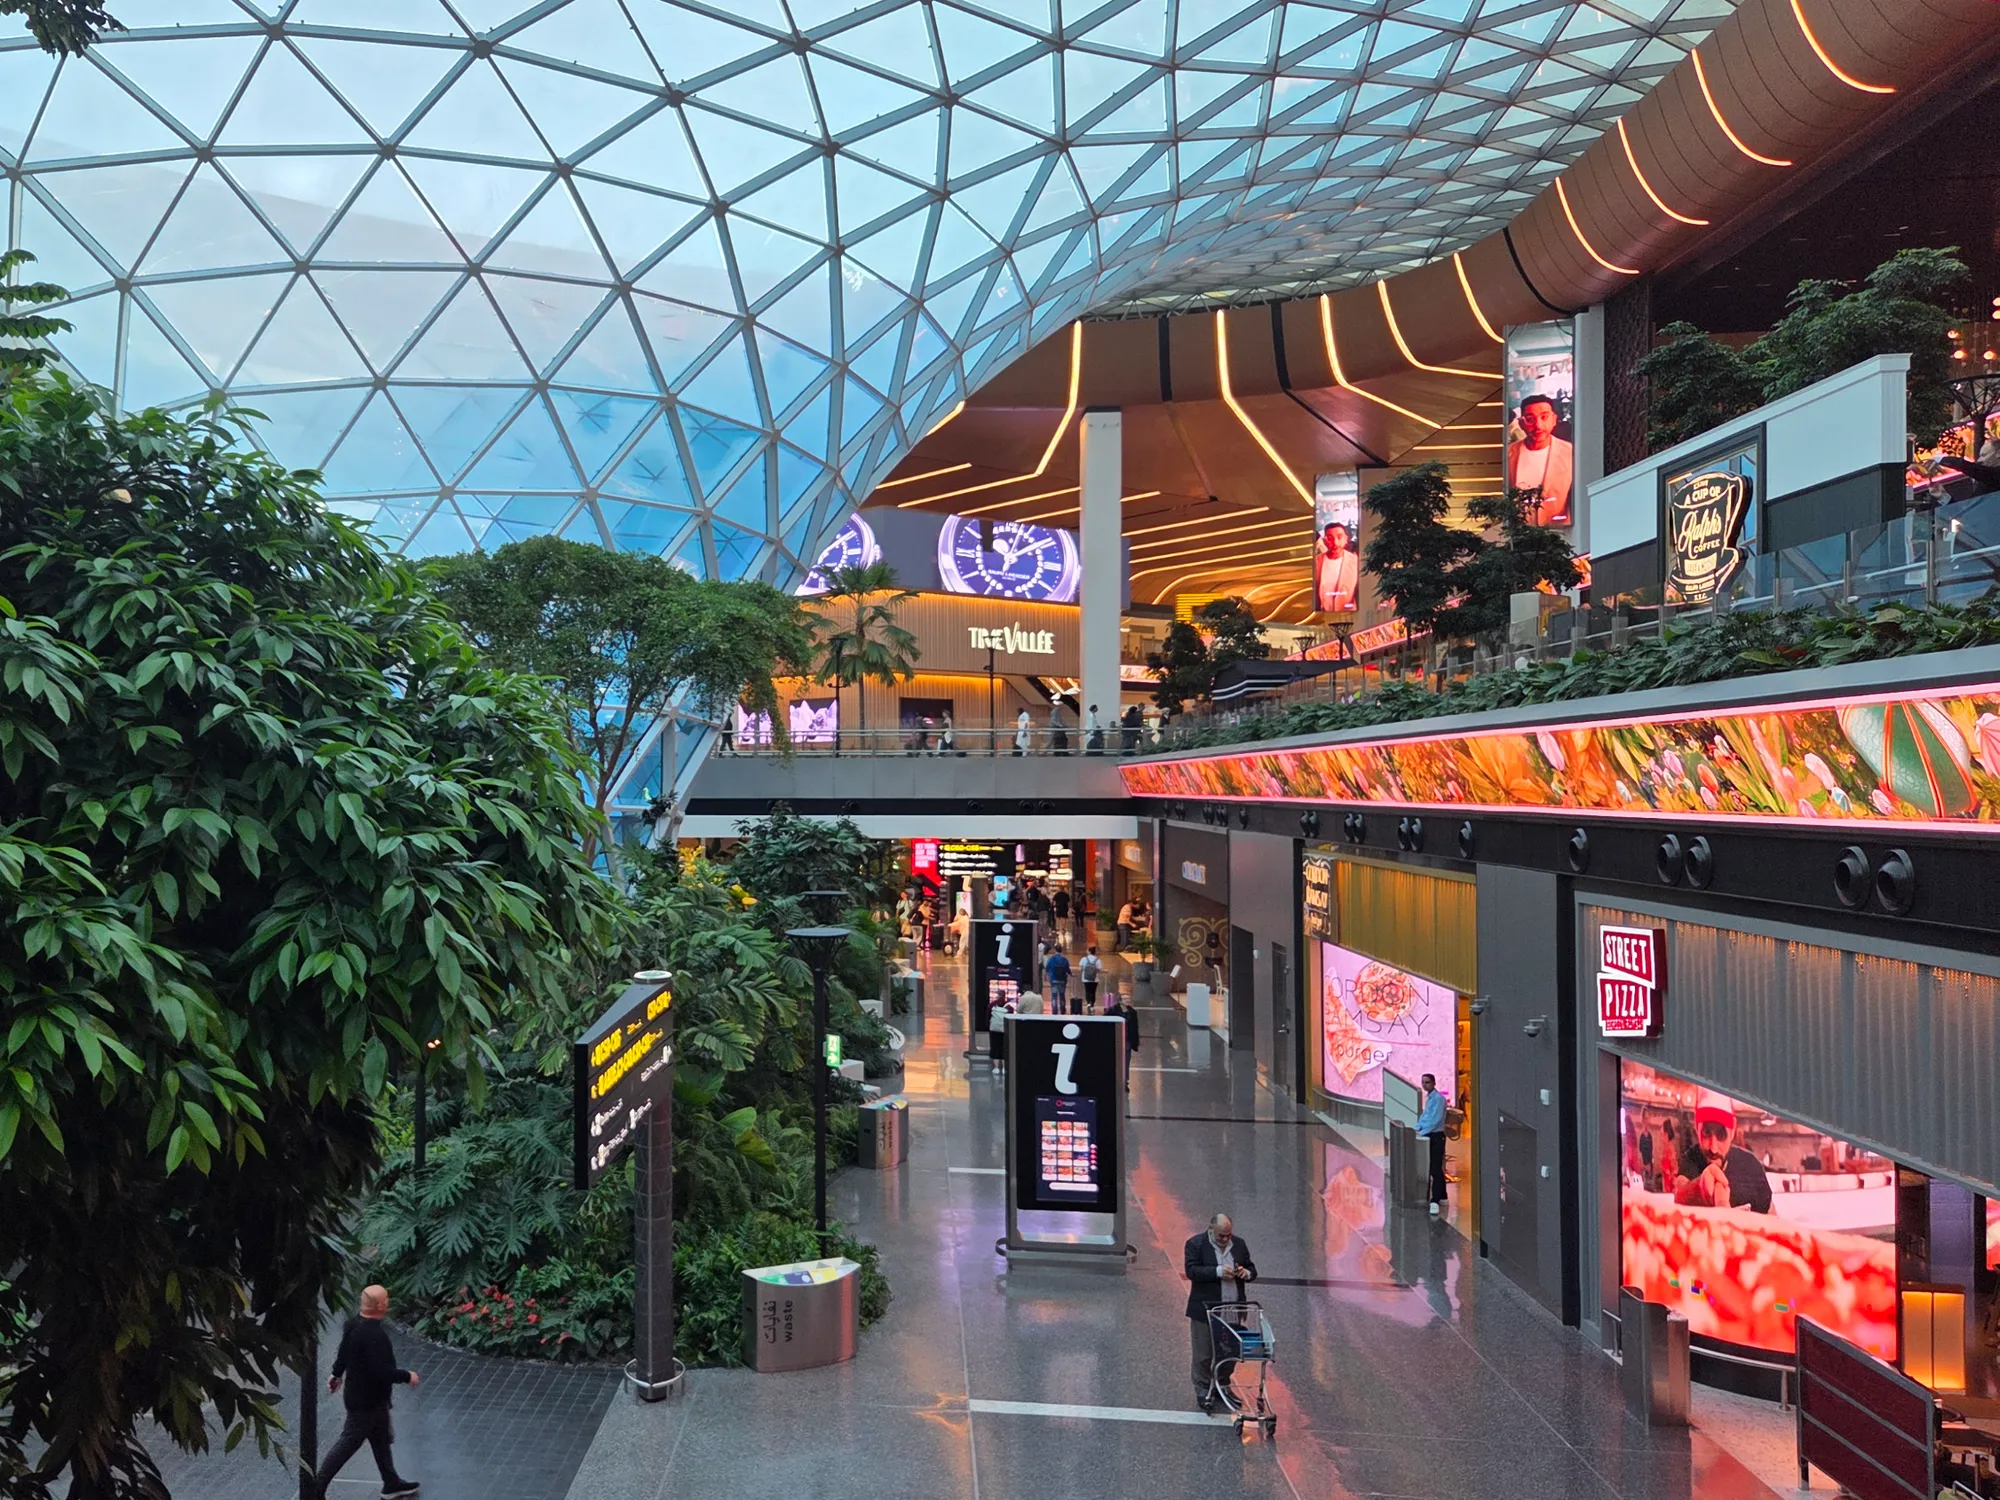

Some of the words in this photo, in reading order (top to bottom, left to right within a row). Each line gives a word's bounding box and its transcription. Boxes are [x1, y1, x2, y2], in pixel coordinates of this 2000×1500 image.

[1692, 487, 1708, 502] CUP
[1709, 485, 1722, 498] OF
[1678, 508, 1722, 559] Ralph's
[1694, 539, 1720, 553] COFFEE
[1605, 934, 1647, 974] STREET
[1604, 983, 1645, 1017] PIZZA
[783, 1300, 793, 1342] waste
